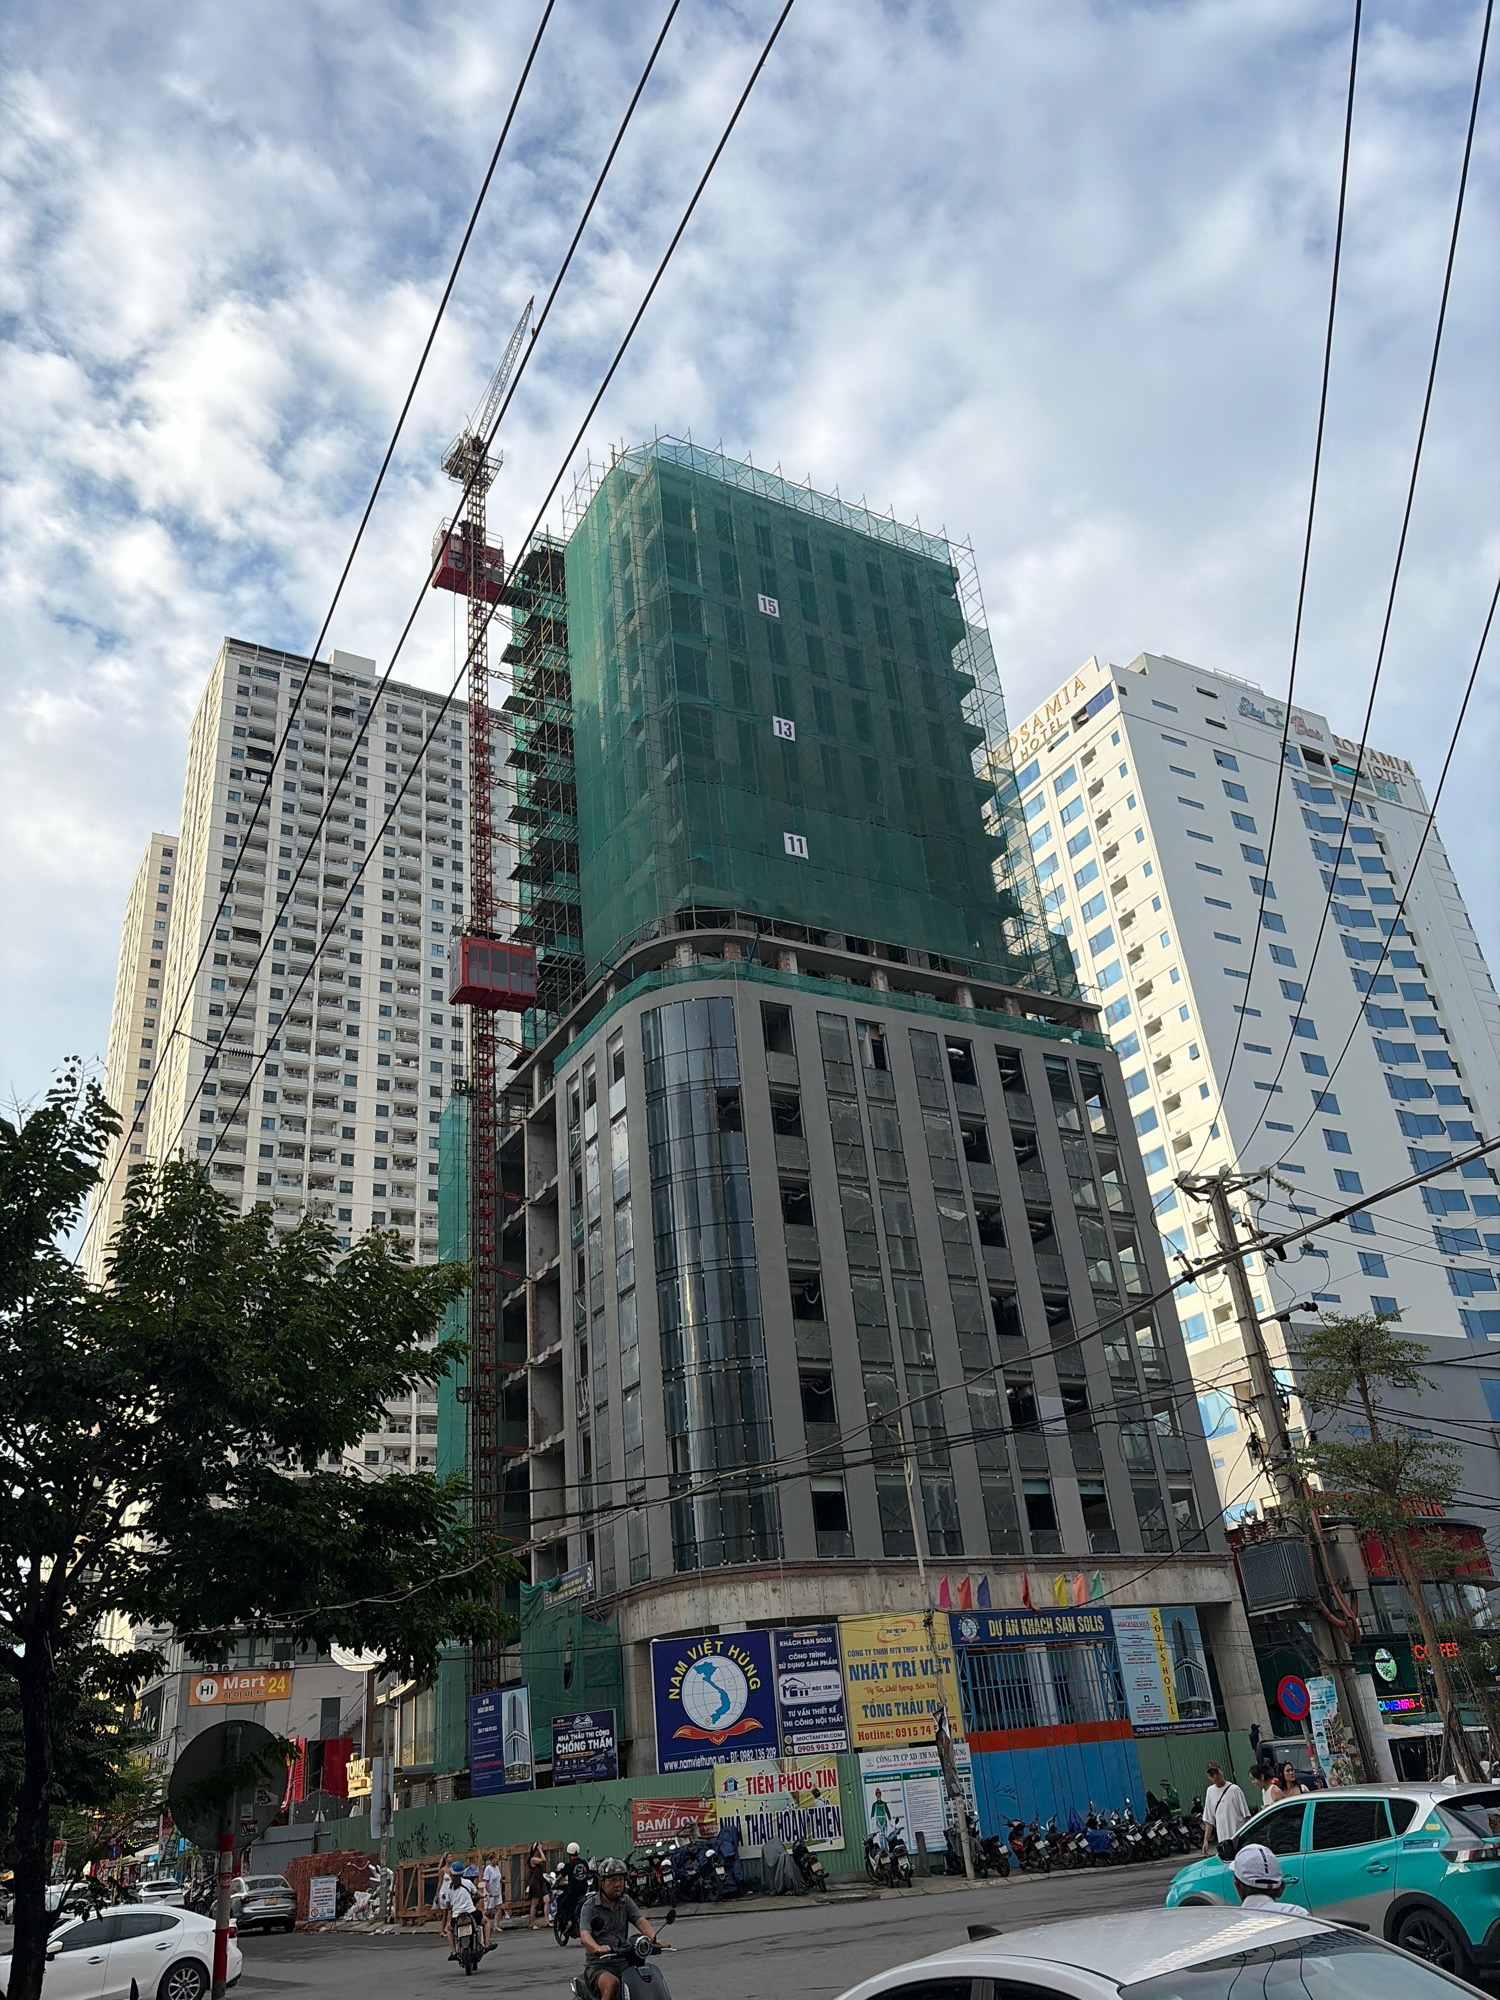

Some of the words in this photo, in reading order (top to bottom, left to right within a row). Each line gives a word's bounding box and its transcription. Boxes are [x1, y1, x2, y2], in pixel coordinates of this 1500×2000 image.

[760, 597, 777, 614] 15
[776, 719, 793, 738] 13
[993, 675, 1086, 765] ROSAMIA
[1020, 717, 1064, 761] HOTEL
[1331, 733, 1414, 776] ROSAMIA
[787, 835, 804, 854] 11
[988, 1619, 1003, 1640] DỰ
[1005, 1616, 1019, 1636] ÁN
[1021, 1614, 1053, 1635] KHÁCH
[1055, 1616, 1076, 1637] SẠN
[1078, 1615, 1105, 1633] SOLIS
[780, 1639, 801, 1647] KHÁCH
[802, 1638, 815, 1646] SẠN
[1153, 1614, 1166, 1661] SOLIS
[788, 1652, 808, 1660] CÔNG
[847, 1648, 864, 1658] CÔNG
[864, 1648, 872, 1656] TY
[873, 1647, 888, 1656] TNHH
[1413, 1643, 1460, 1659] CFEE
[669, 1660, 688, 1700] NAM
[687, 1638, 724, 1660] VIỆT
[848, 1659, 889, 1684] NHẬT
[892, 1656, 917, 1678] TRÍ
[919, 1656, 952, 1676] VIT
[223, 1675, 266, 1690] Mart
[268, 1676, 286, 1694] 24
[223, 1689, 264, 1699] 하이마트
[1162, 1667, 1176, 1715] HOTEL
[862, 1697, 893, 1719] TỔNG
[894, 1695, 924, 1716] THẦU
[1377, 1698, 1415, 1712] OUVENIRS
[783, 1720, 793, 1728] THI
[794, 1718, 814, 1727] CÔNG
[815, 1715, 828, 1725] NỘI
[828, 1713, 844, 1723] THẤT
[558, 1733, 569, 1742] NHÀ
[595, 1728, 610, 1738] CÔNG
[857, 1729, 894, 1742] Hotline:
[895, 1726, 918, 1738] 0915
[920, 1725, 932, 1736] 74
[556, 1738, 586, 1754] CHỐNG
[587, 1735, 613, 1750] THẤM
[797, 1744, 815, 1753] 0905
[816, 1743, 829, 1751] 982
[830, 1742, 844, 1750] 377
[745, 1769, 775, 1795] TIẾN
[778, 1767, 813, 1792] PHÚC
[815, 1765, 837, 1788] TÍN
[637, 1818, 671, 1832] BAMI
[745, 1801, 774, 1846] THẦU
[776, 1802, 808, 1843] HOÀN
[809, 1799, 842, 1845] THIỆN
